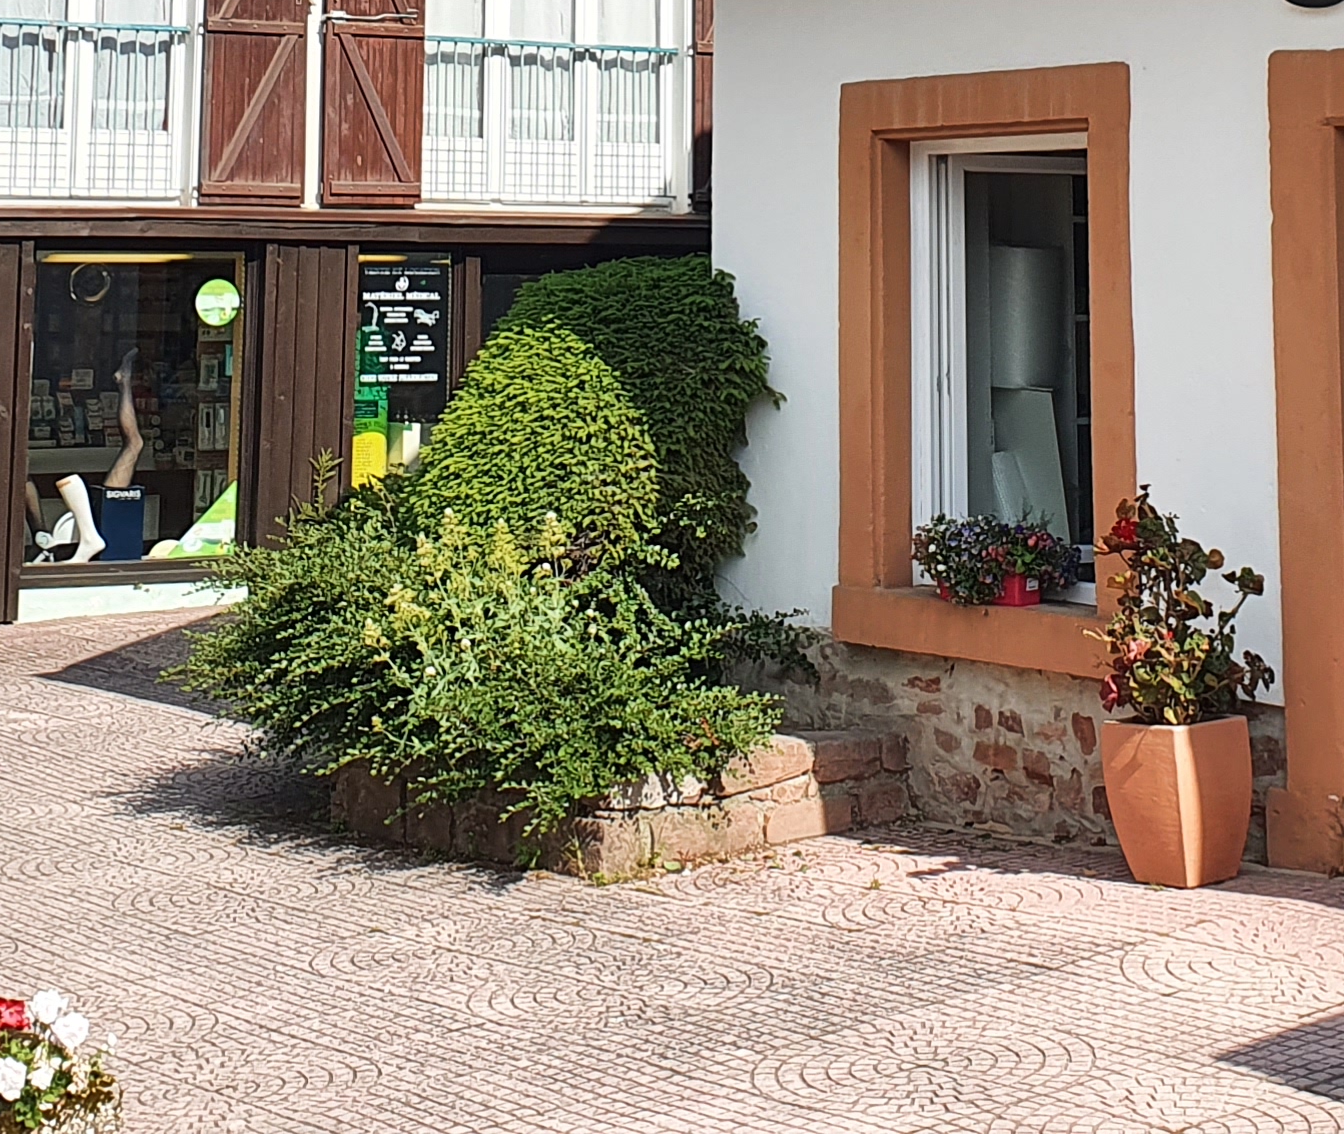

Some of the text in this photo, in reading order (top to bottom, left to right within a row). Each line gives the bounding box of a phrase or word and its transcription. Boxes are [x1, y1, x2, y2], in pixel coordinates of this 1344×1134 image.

[362, 291, 441, 300] MATÉRIEL MÉDICAL
[106, 490, 142, 499] SIGVARIS
